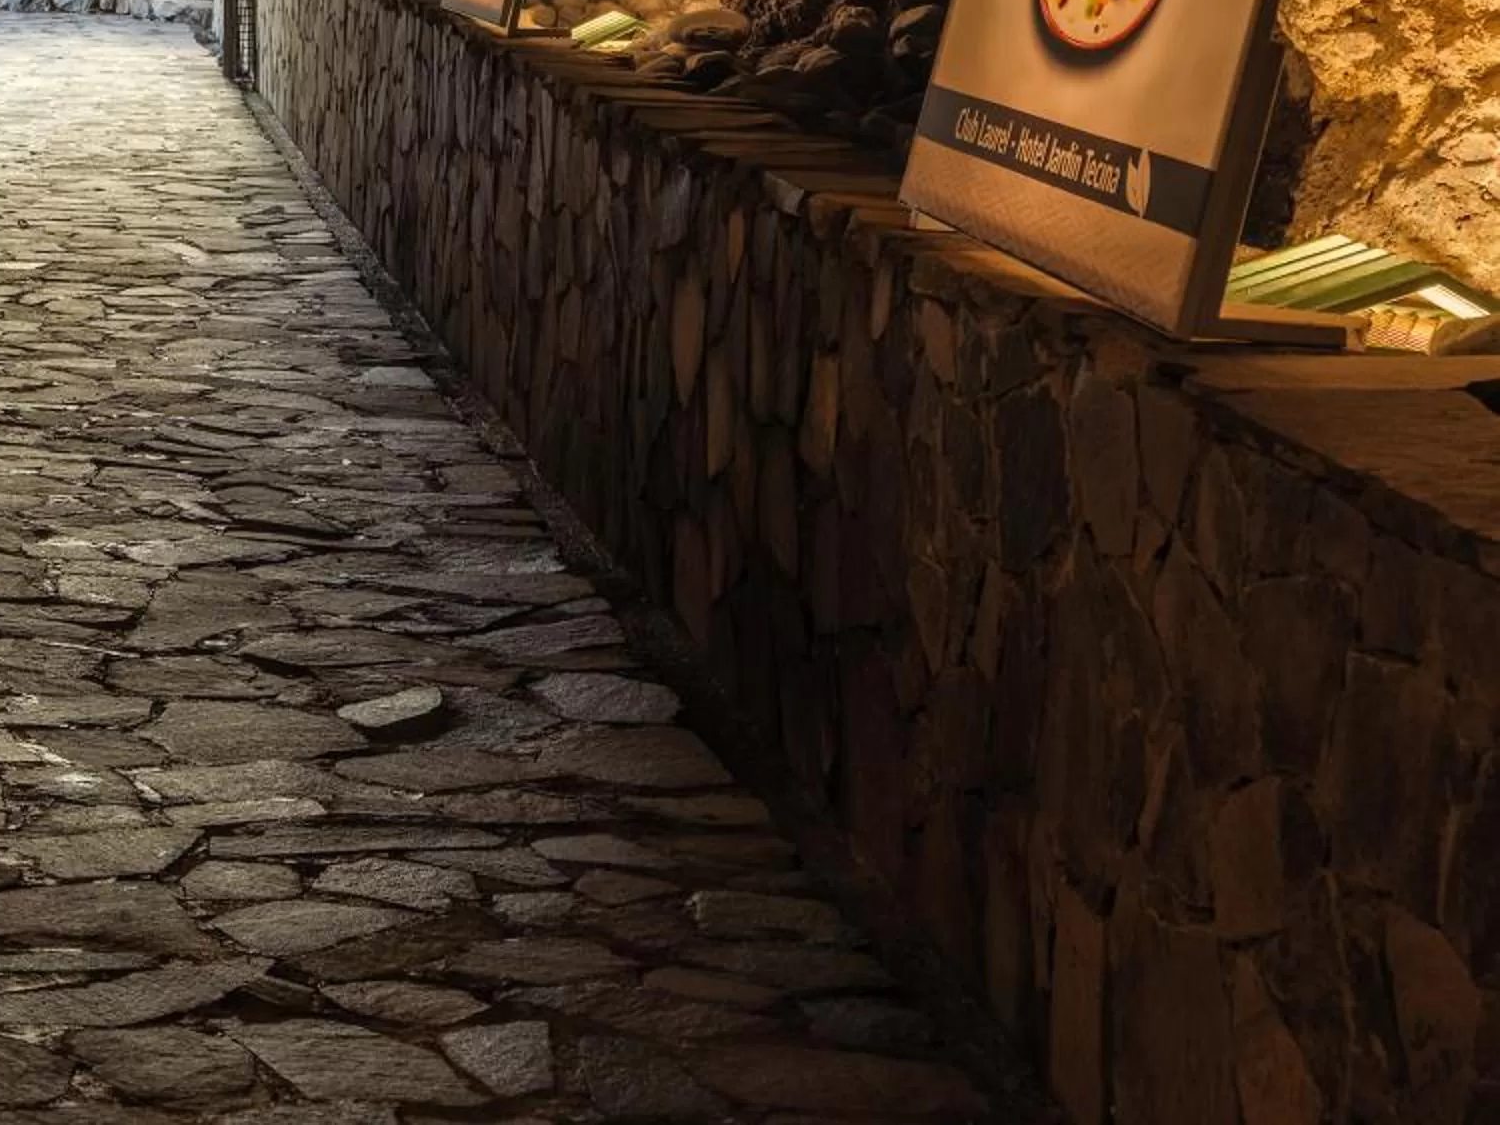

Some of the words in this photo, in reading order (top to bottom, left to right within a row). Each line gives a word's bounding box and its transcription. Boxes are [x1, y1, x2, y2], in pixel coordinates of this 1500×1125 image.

[955, 107, 977, 144] Club
[977, 114, 1011, 155] Laurel
[1015, 126, 1050, 168] Hotel
[1082, 149, 1121, 194] Tecina
